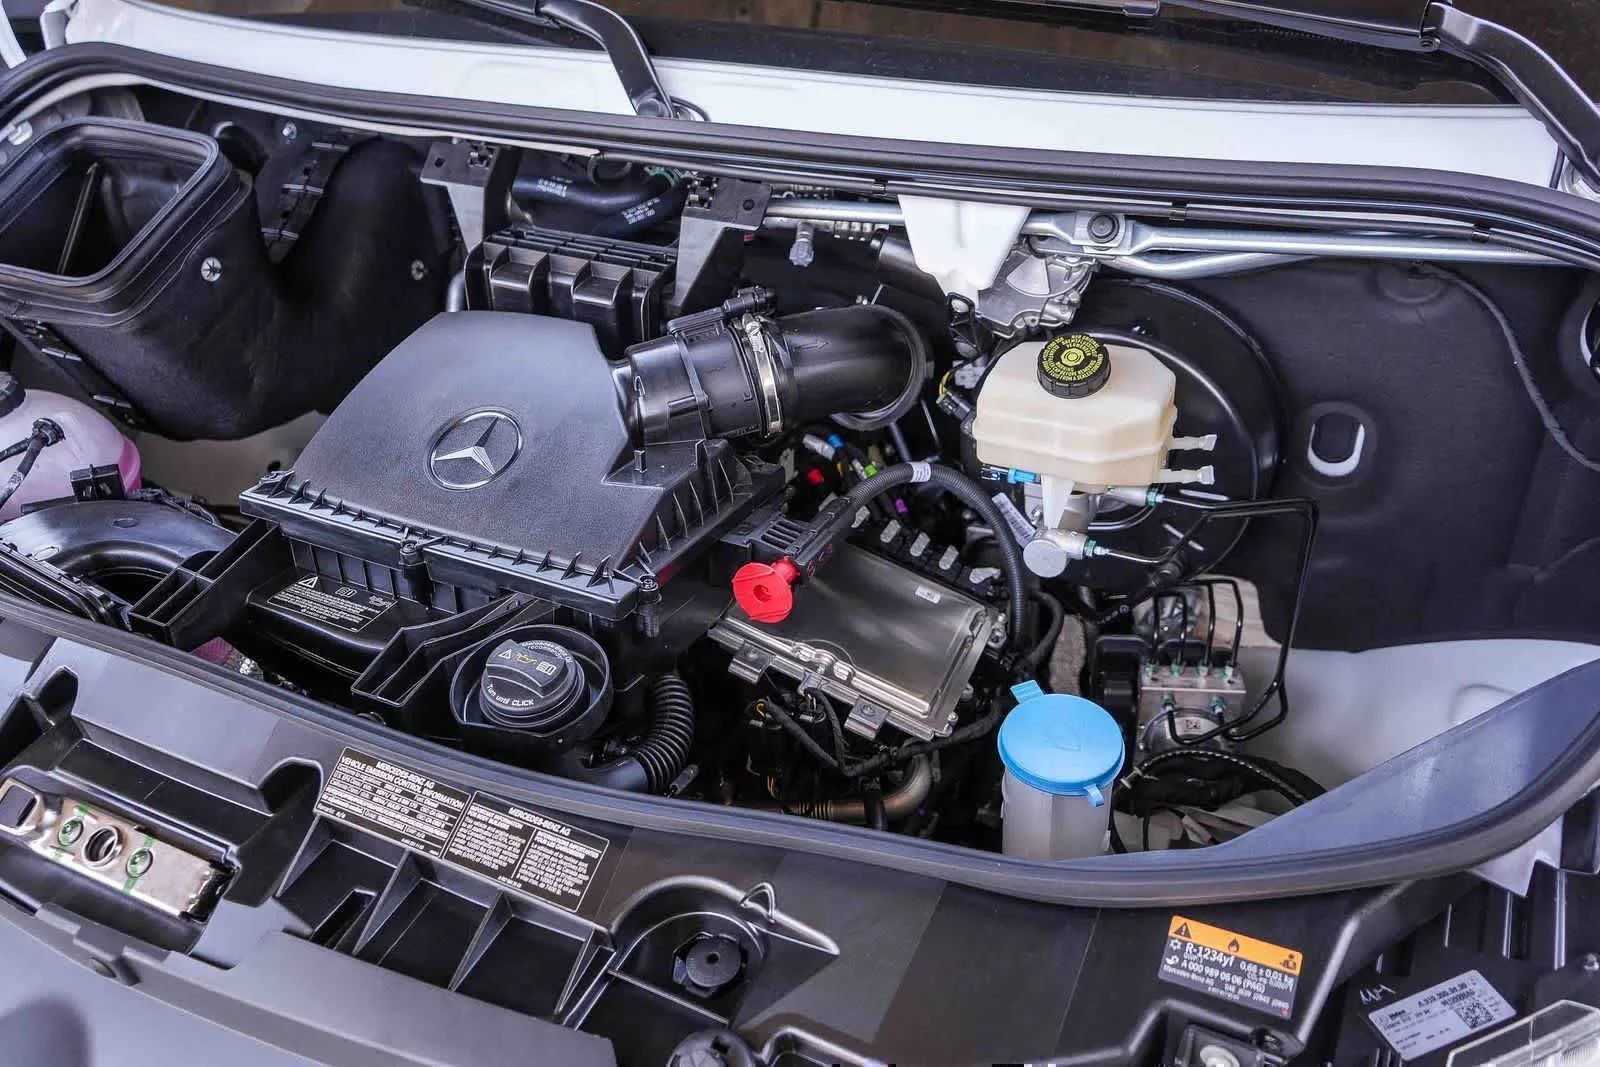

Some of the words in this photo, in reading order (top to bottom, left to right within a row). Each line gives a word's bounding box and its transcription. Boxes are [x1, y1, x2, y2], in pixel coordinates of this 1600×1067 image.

[495, 695, 510, 705] until
[341, 756, 365, 770] VEHICLE
[365, 766, 394, 781] EMISSION
[393, 777, 422, 792] CONTROL
[422, 788, 463, 808] INFORMATION
[376, 762, 423, 784] MERCEDES-BENZ
[424, 780, 434, 788] AG
[508, 807, 560, 831] MERCEDES-BENZ
[560, 827, 570, 835] AG
[1184, 942, 1234, 969] R-1234yf
